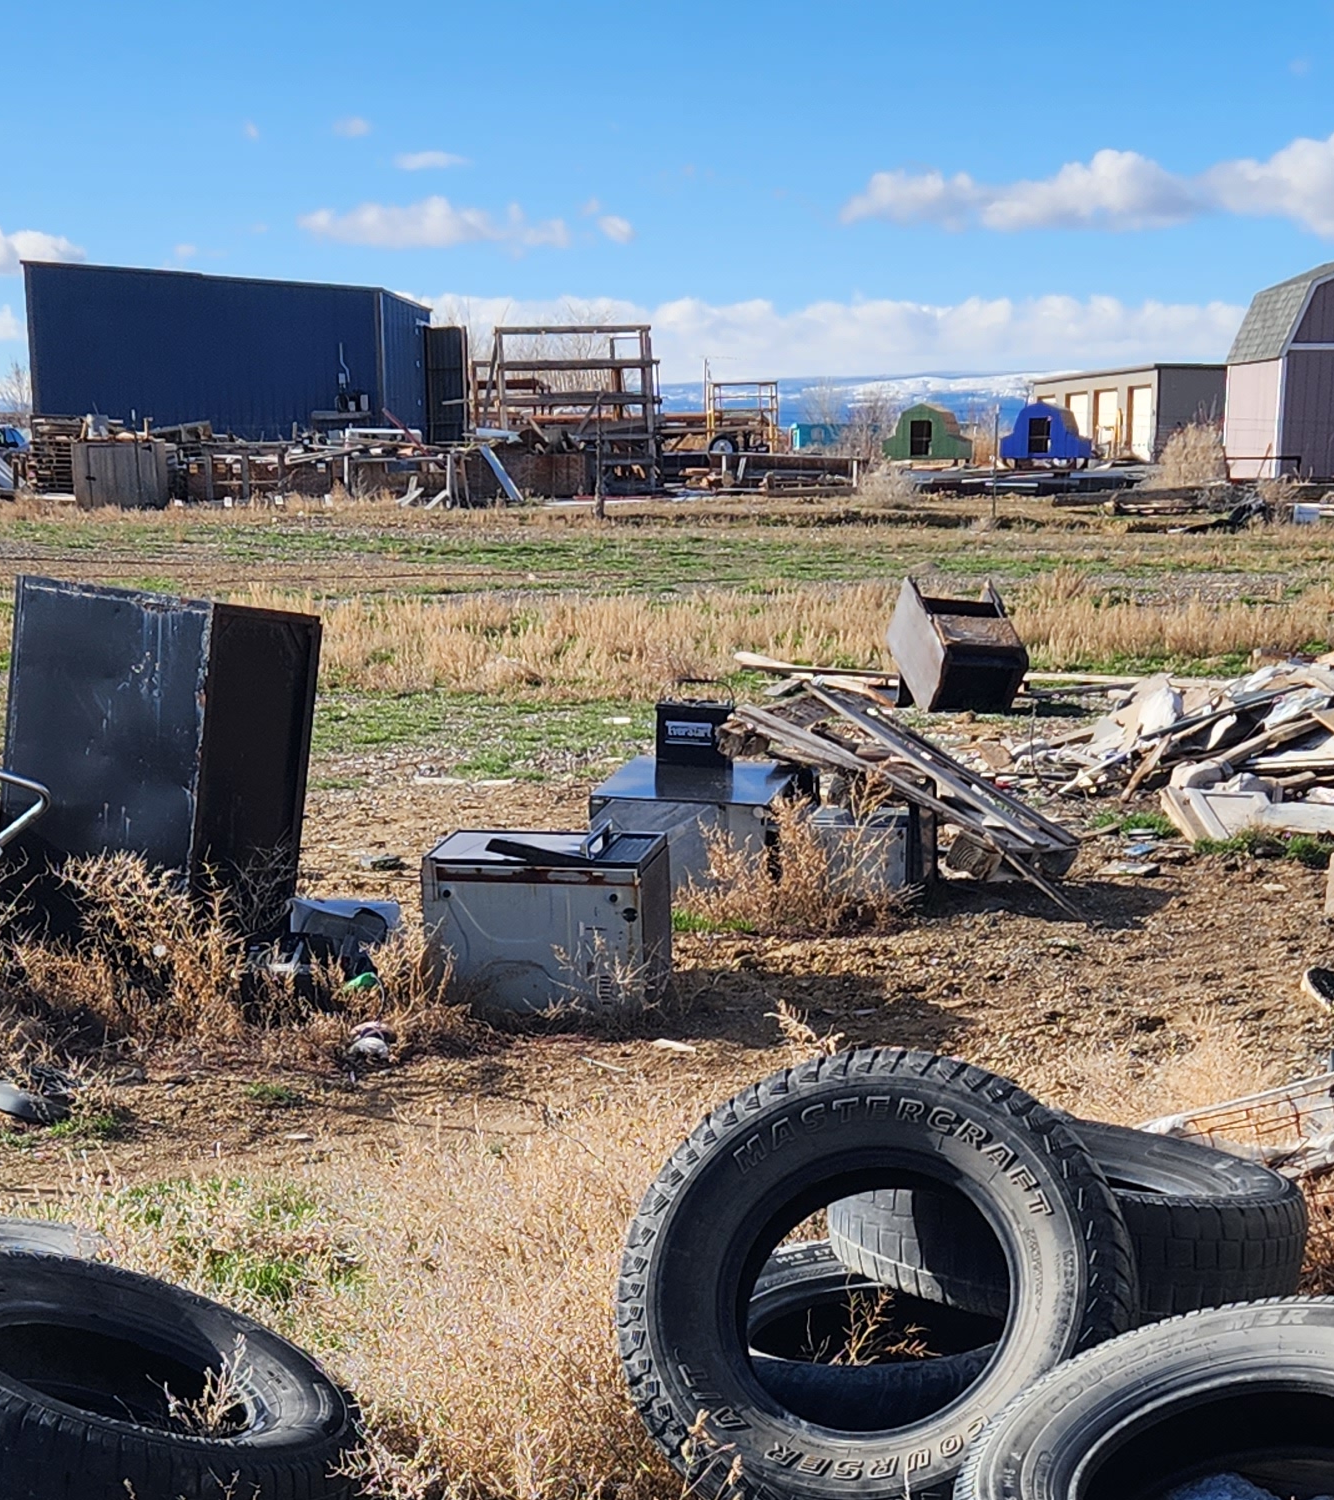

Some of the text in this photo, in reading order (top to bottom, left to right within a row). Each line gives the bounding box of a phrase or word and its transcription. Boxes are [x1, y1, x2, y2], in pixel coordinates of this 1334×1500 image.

[733, 1095, 1053, 1217] MASTERCRAFT
[1043, 1328, 1200, 1413] COURSER
[1224, 1309, 1310, 1332] MSR
[764, 1415, 992, 1481] COURSER
